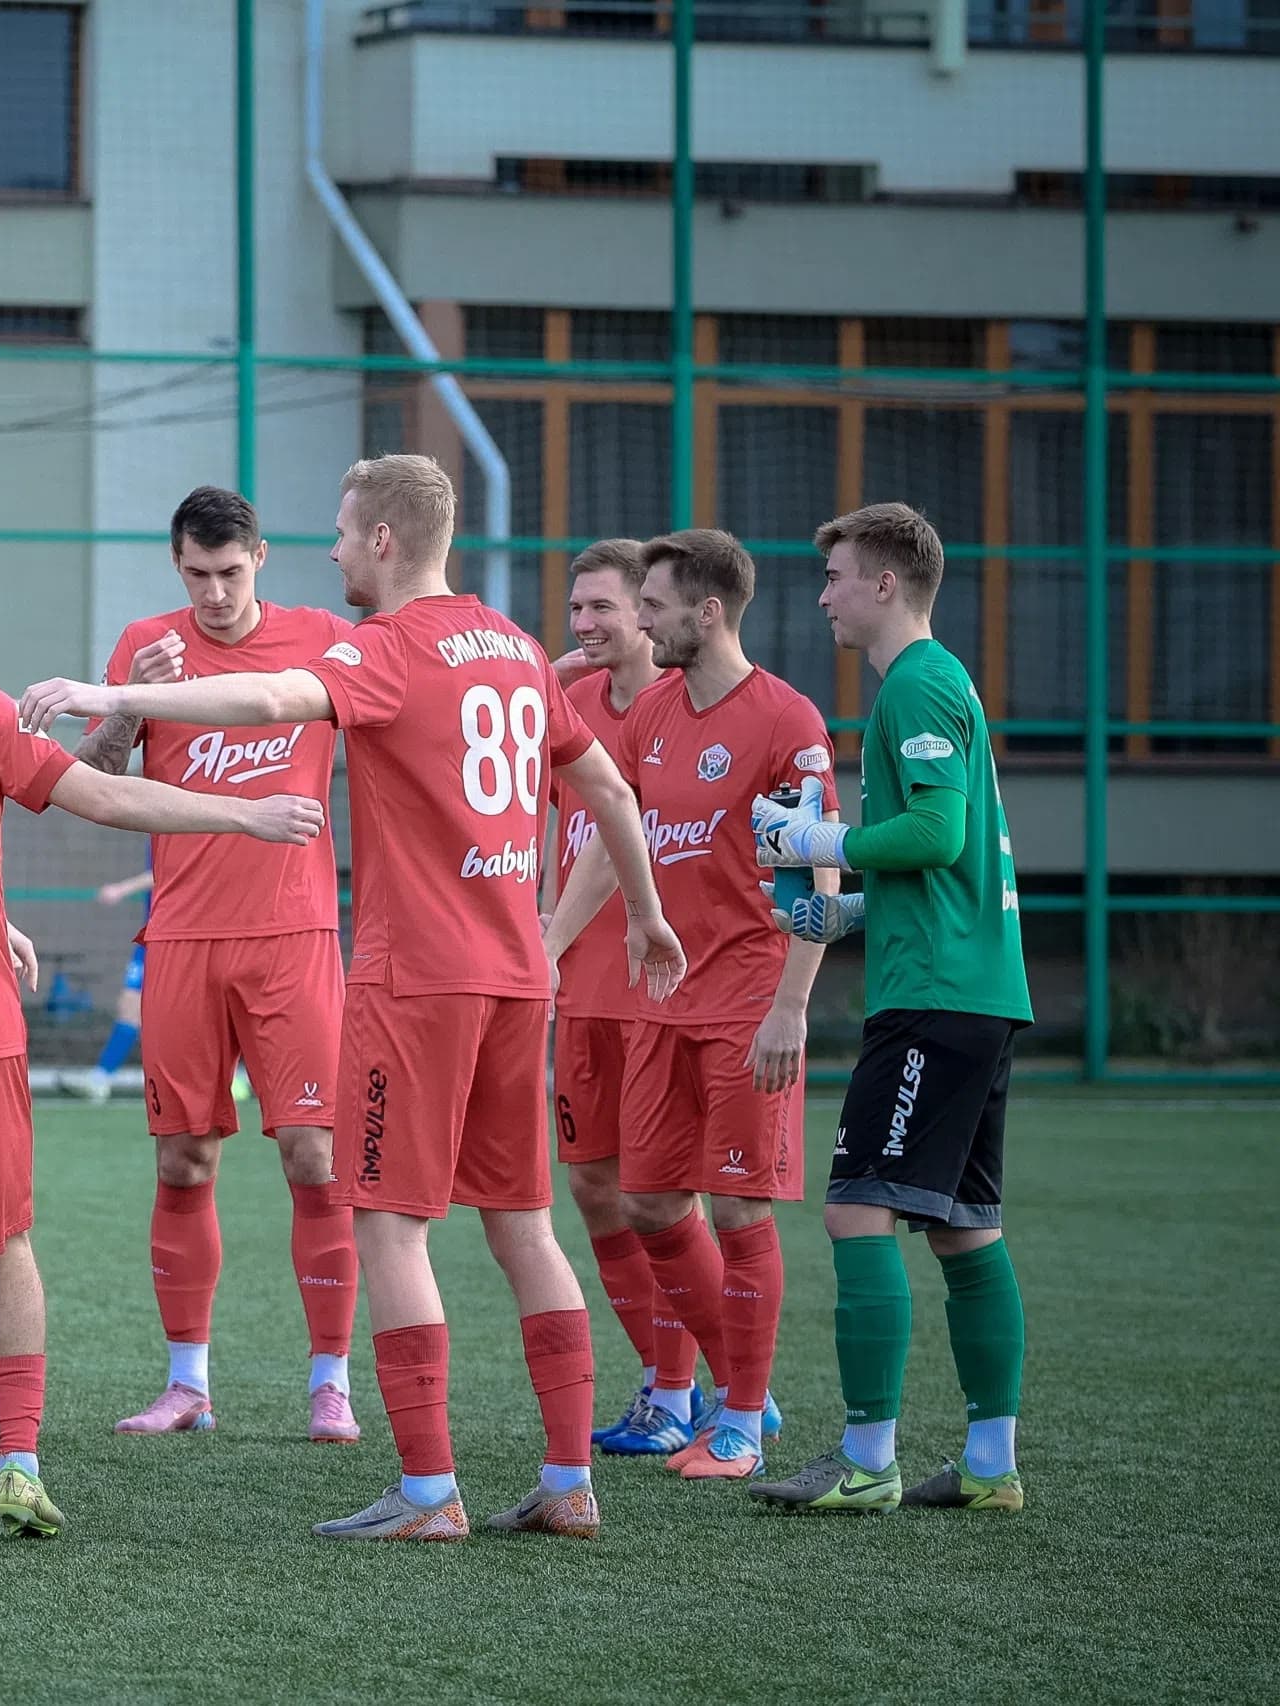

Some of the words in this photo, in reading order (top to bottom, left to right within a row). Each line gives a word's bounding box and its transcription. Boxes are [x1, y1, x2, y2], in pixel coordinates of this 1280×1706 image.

[181, 724, 305, 784] Ярче!
[460, 684, 546, 816] 88
[905, 741, 951, 756] Яшкино
[460, 835, 538, 884] babyf
[641, 807, 728, 865] Ярче!
[557, 1094, 577, 1144] 6
